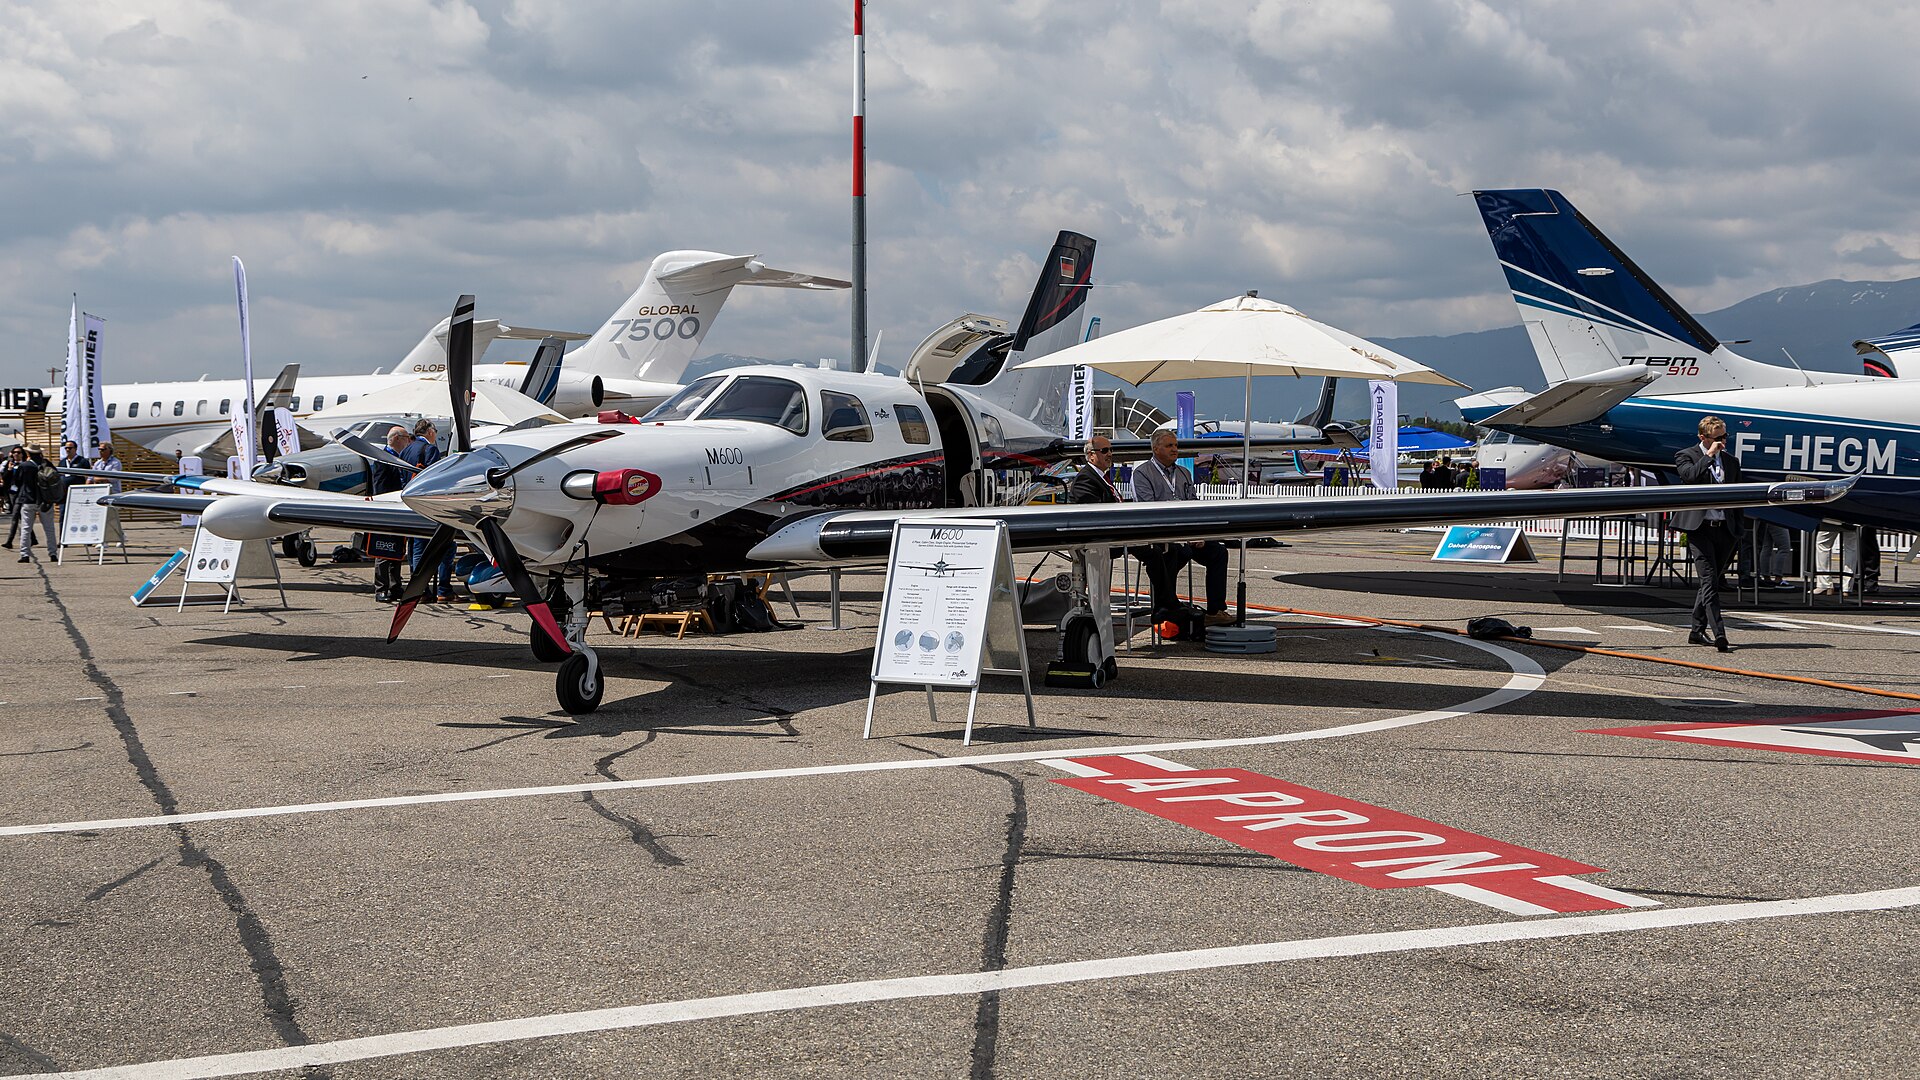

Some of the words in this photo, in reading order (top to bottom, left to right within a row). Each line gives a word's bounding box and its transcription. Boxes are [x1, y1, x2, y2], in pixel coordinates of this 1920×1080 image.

[639, 304, 700, 316] GLOBAL
[608, 316, 700, 342] 7500
[1621, 356, 1698, 367] TBM
[413, 363, 447, 373] GLOB
[1665, 366, 1700, 376] 910
[0, 388, 44, 411] IER
[705, 447, 743, 465] M600
[1734, 432, 1897, 475] F-HEGM
[335, 463, 353, 473] M350
[930, 528, 964, 541] M600
[1467, 543, 1502, 551] Aerospace
[951, 670, 968, 678] Piper
[1098, 776, 1540, 880] APRON
